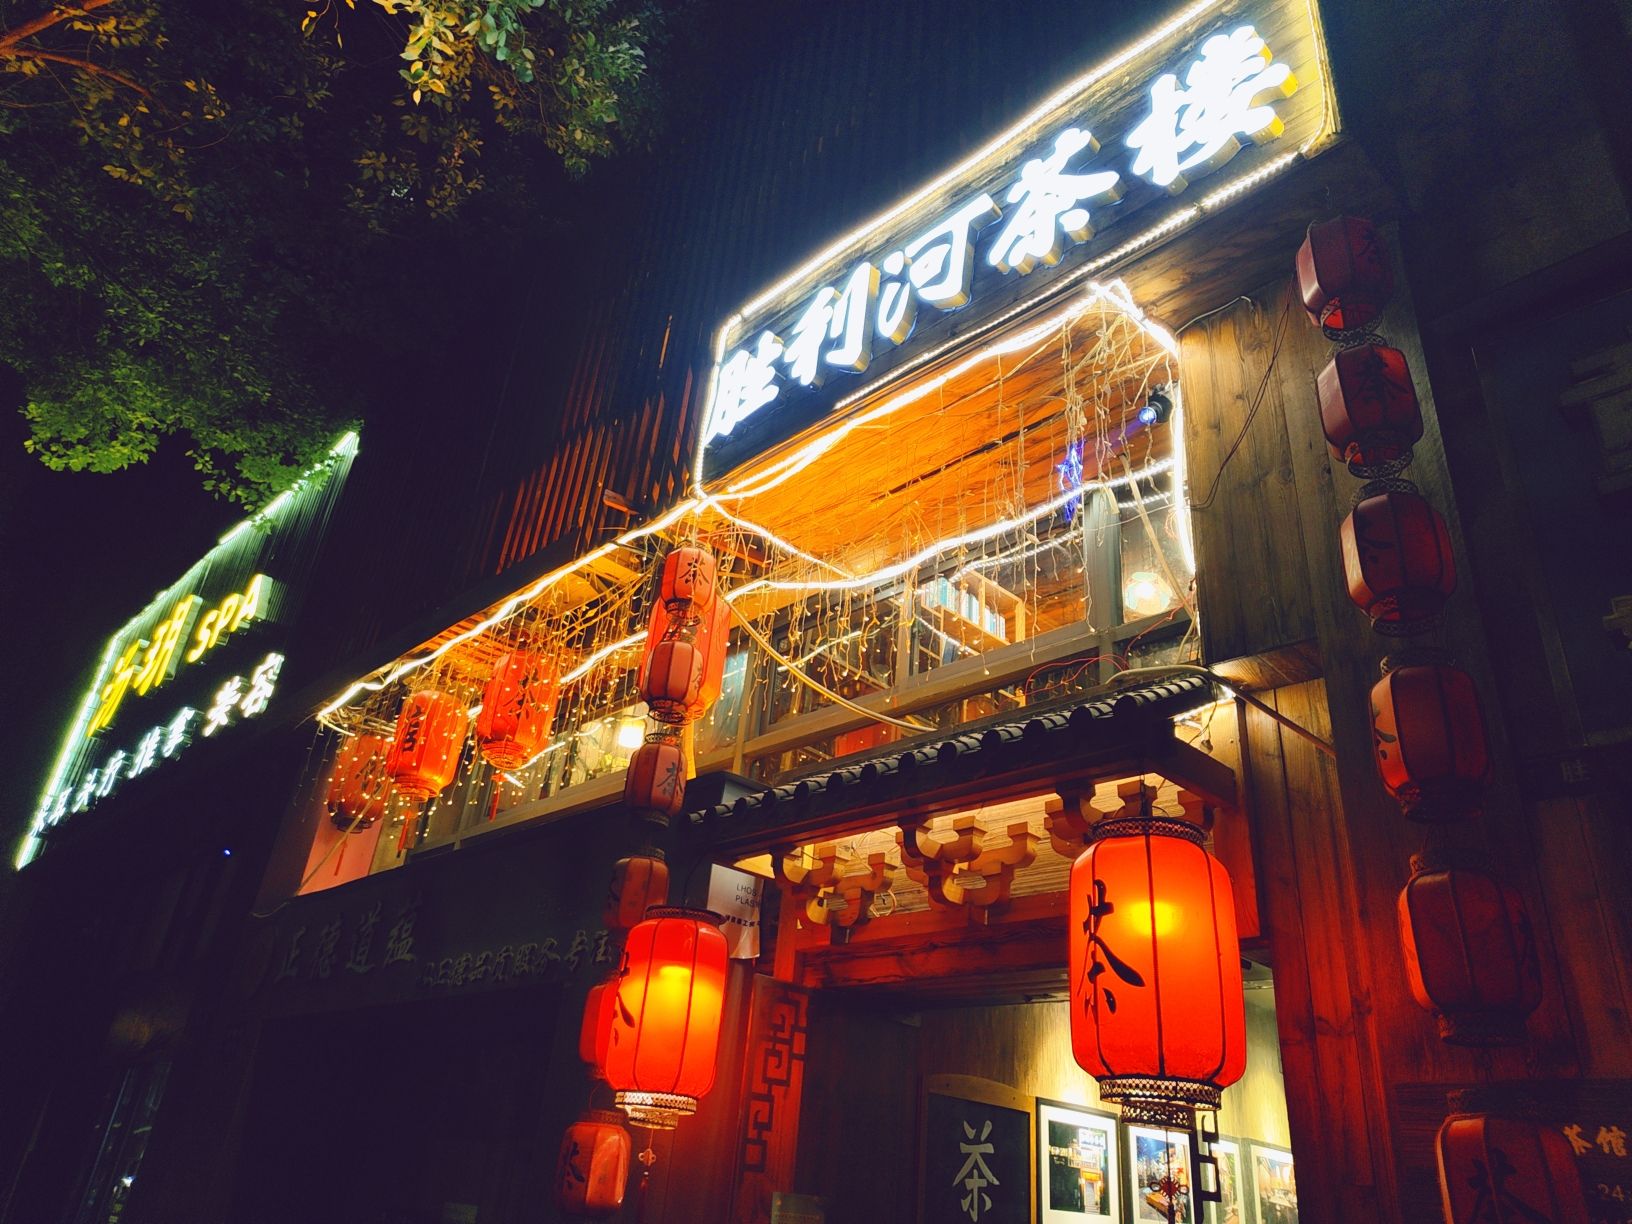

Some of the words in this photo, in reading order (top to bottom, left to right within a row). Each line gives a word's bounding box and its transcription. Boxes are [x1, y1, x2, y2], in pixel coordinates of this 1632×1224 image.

[705, 25, 1290, 441] 胜利河茶楼
[187, 573, 264, 664] SPA
[952, 1119, 1000, 1223] 茶
